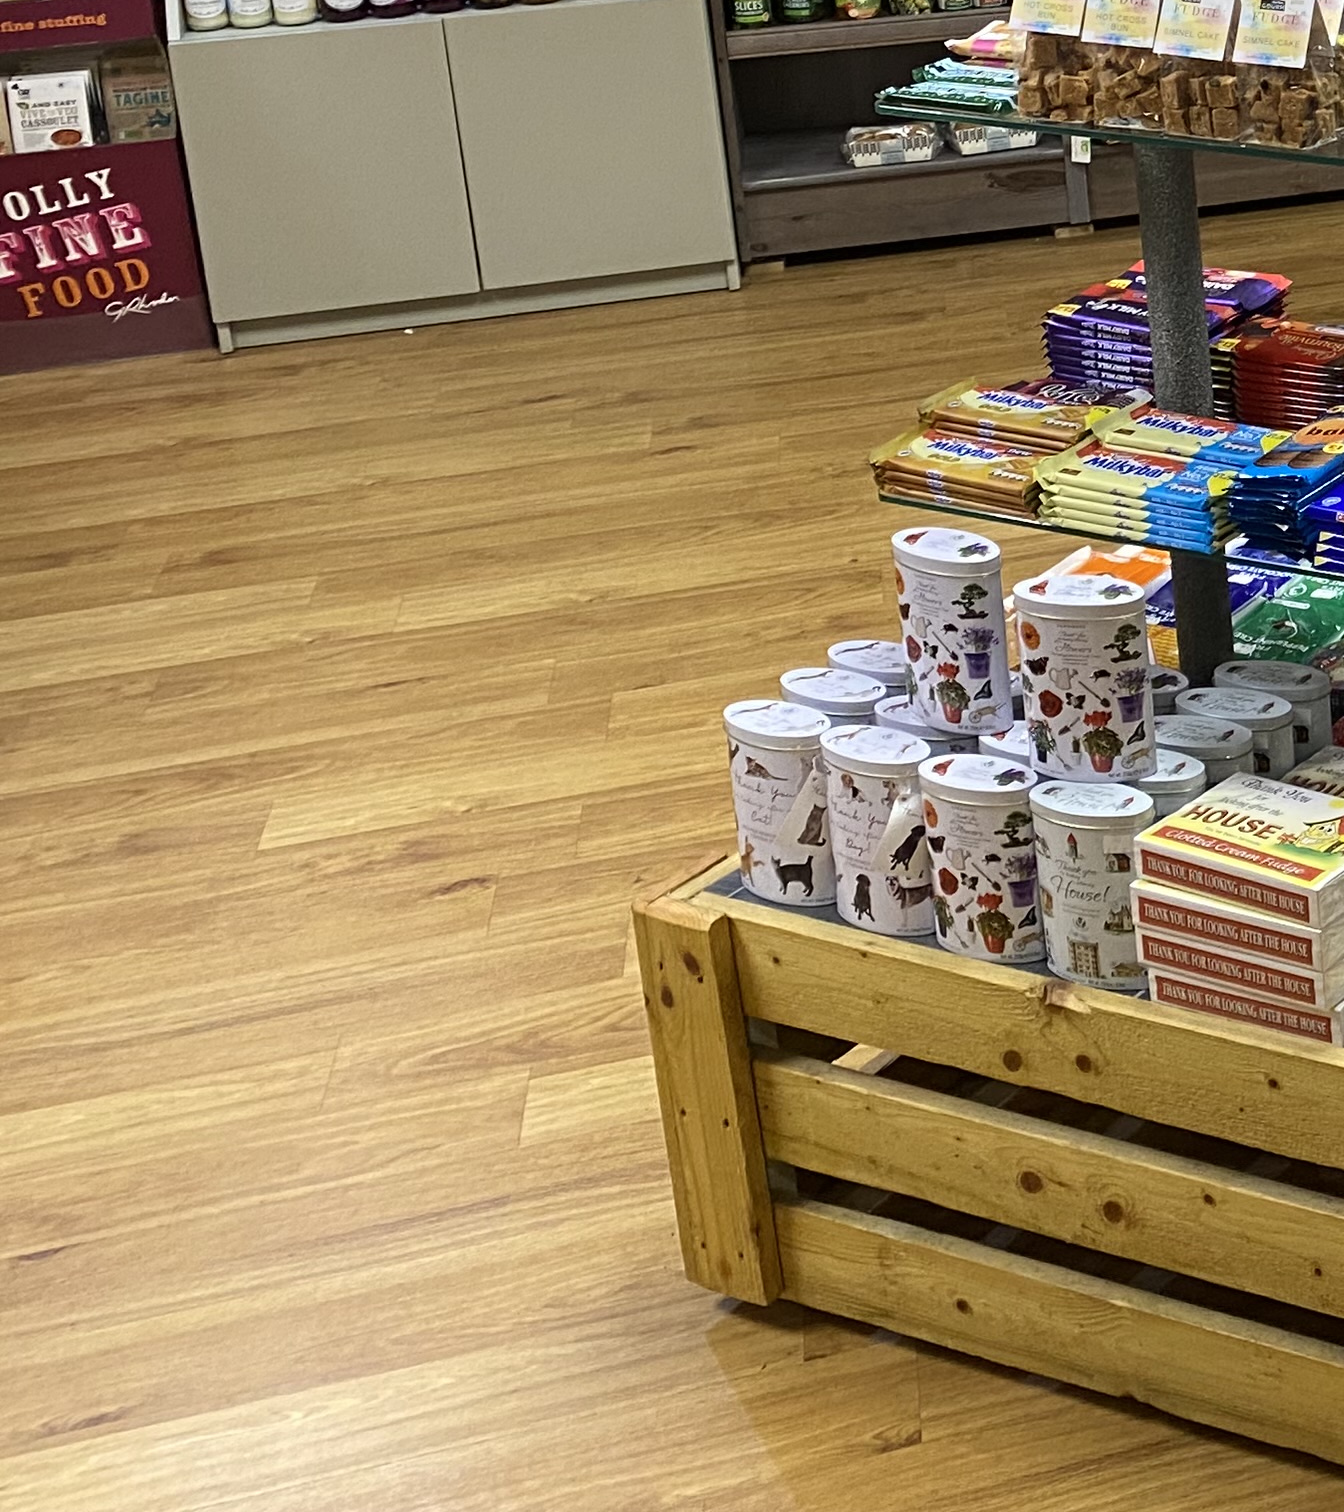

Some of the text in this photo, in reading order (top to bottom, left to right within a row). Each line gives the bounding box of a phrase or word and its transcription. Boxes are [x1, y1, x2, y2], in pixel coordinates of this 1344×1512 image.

[734, 0, 763, 11] SLICES
[1174, 3, 1219, 18] FUDGE
[1252, 11, 1299, 25] FUDGE
[39, 13, 107, 27] stuffing
[1110, 23, 1129, 33] BUN
[21, 116, 78, 127] CASSOULET
[17, 258, 150, 317] FOOD
[978, 390, 1048, 411] Milkybar
[1136, 414, 1220, 439] Milkybar
[930, 439, 998, 461] Milkybar
[1086, 454, 1174, 479] Milkybar
[1241, 778, 1313, 804] Thank You
[1181, 804, 1284, 840] HOUSE
[1165, 829, 1305, 875] Clotted Cream Fudge
[1147, 856, 1306, 915] THANK YOU FOR LOOKING AFTER THE HOUSE
[1144, 903, 1309, 958] THANK YOU FOR LOOKING AFTER THE HOUSE
[1148, 942, 1312, 997] THANK YOU FOR LOOKING AFTER THE HOUSE
